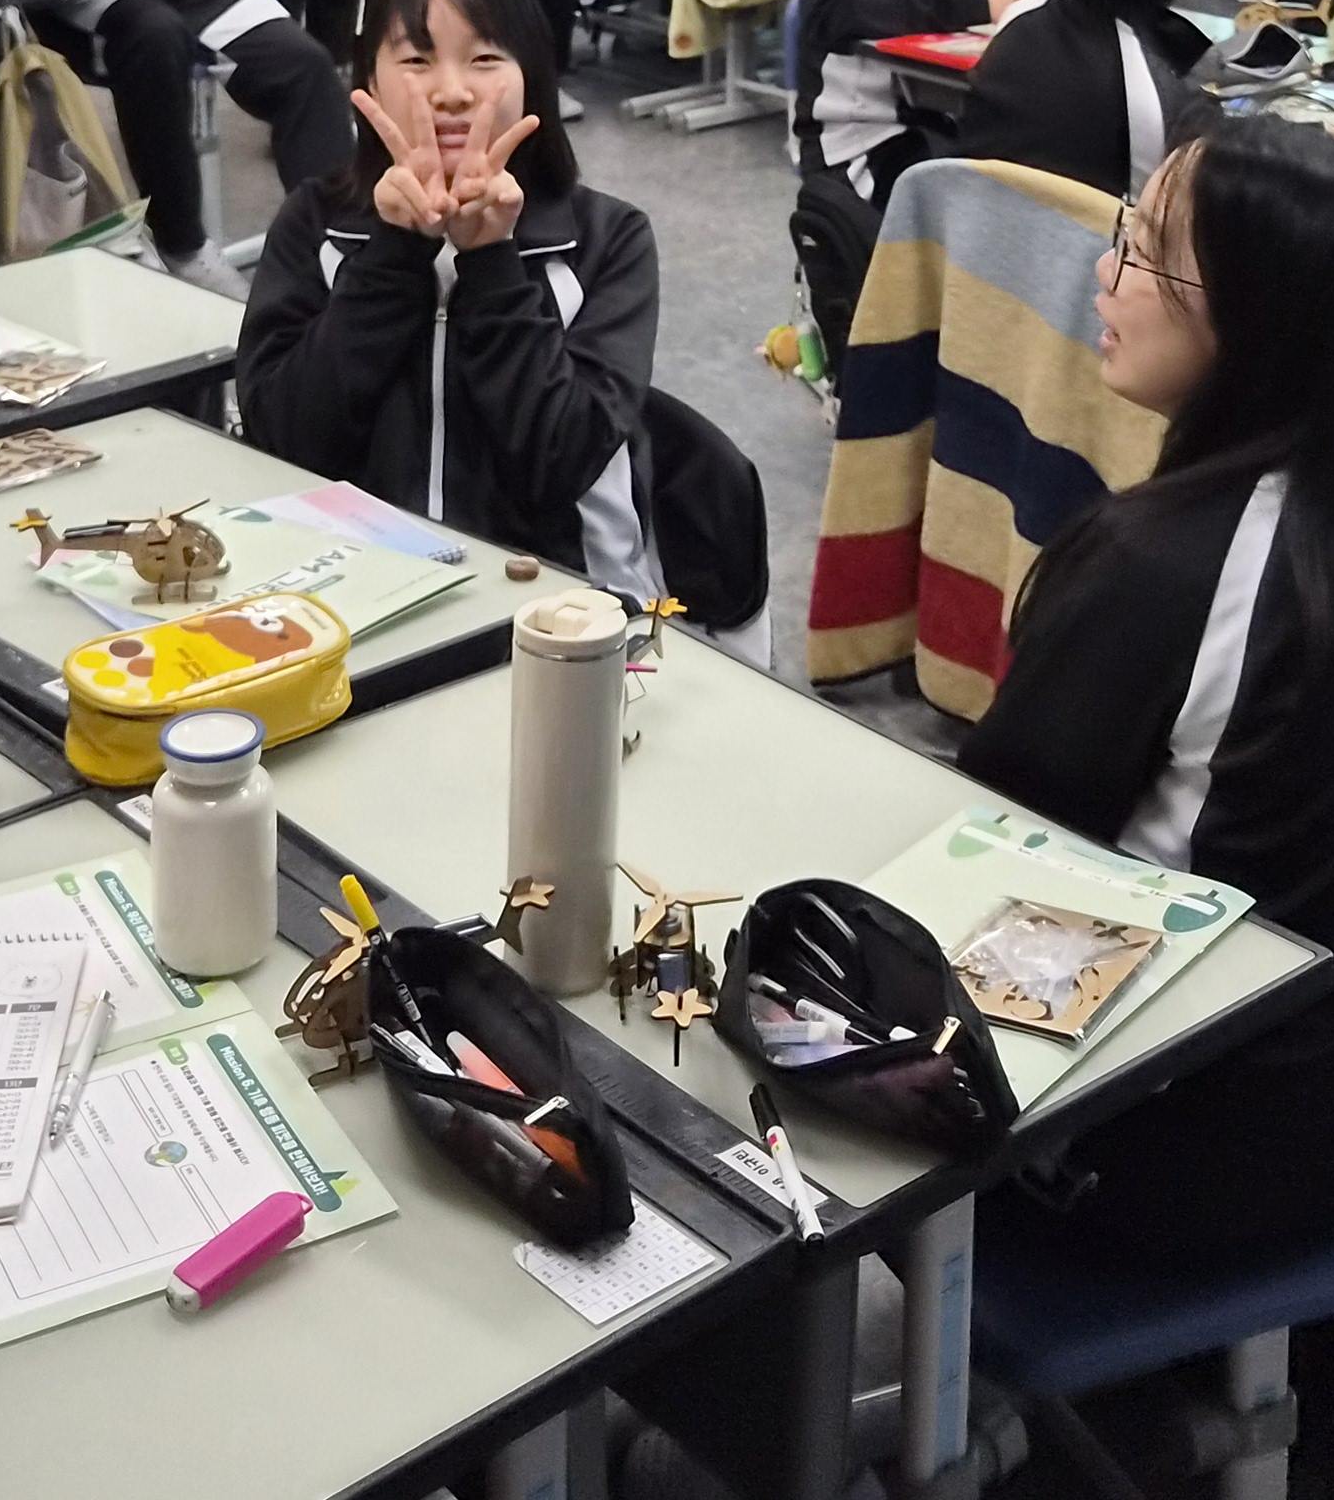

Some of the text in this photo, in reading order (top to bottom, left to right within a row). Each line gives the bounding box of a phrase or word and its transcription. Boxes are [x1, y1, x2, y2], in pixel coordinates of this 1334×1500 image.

[299, 549, 345, 573] AM
[103, 875, 128, 905] Mission
[218, 1043, 249, 1081] Mission
[240, 1076, 256, 1091] 6.
[246, 1086, 268, 1109] 기후
[730, 1145, 771, 1178] 이규민
